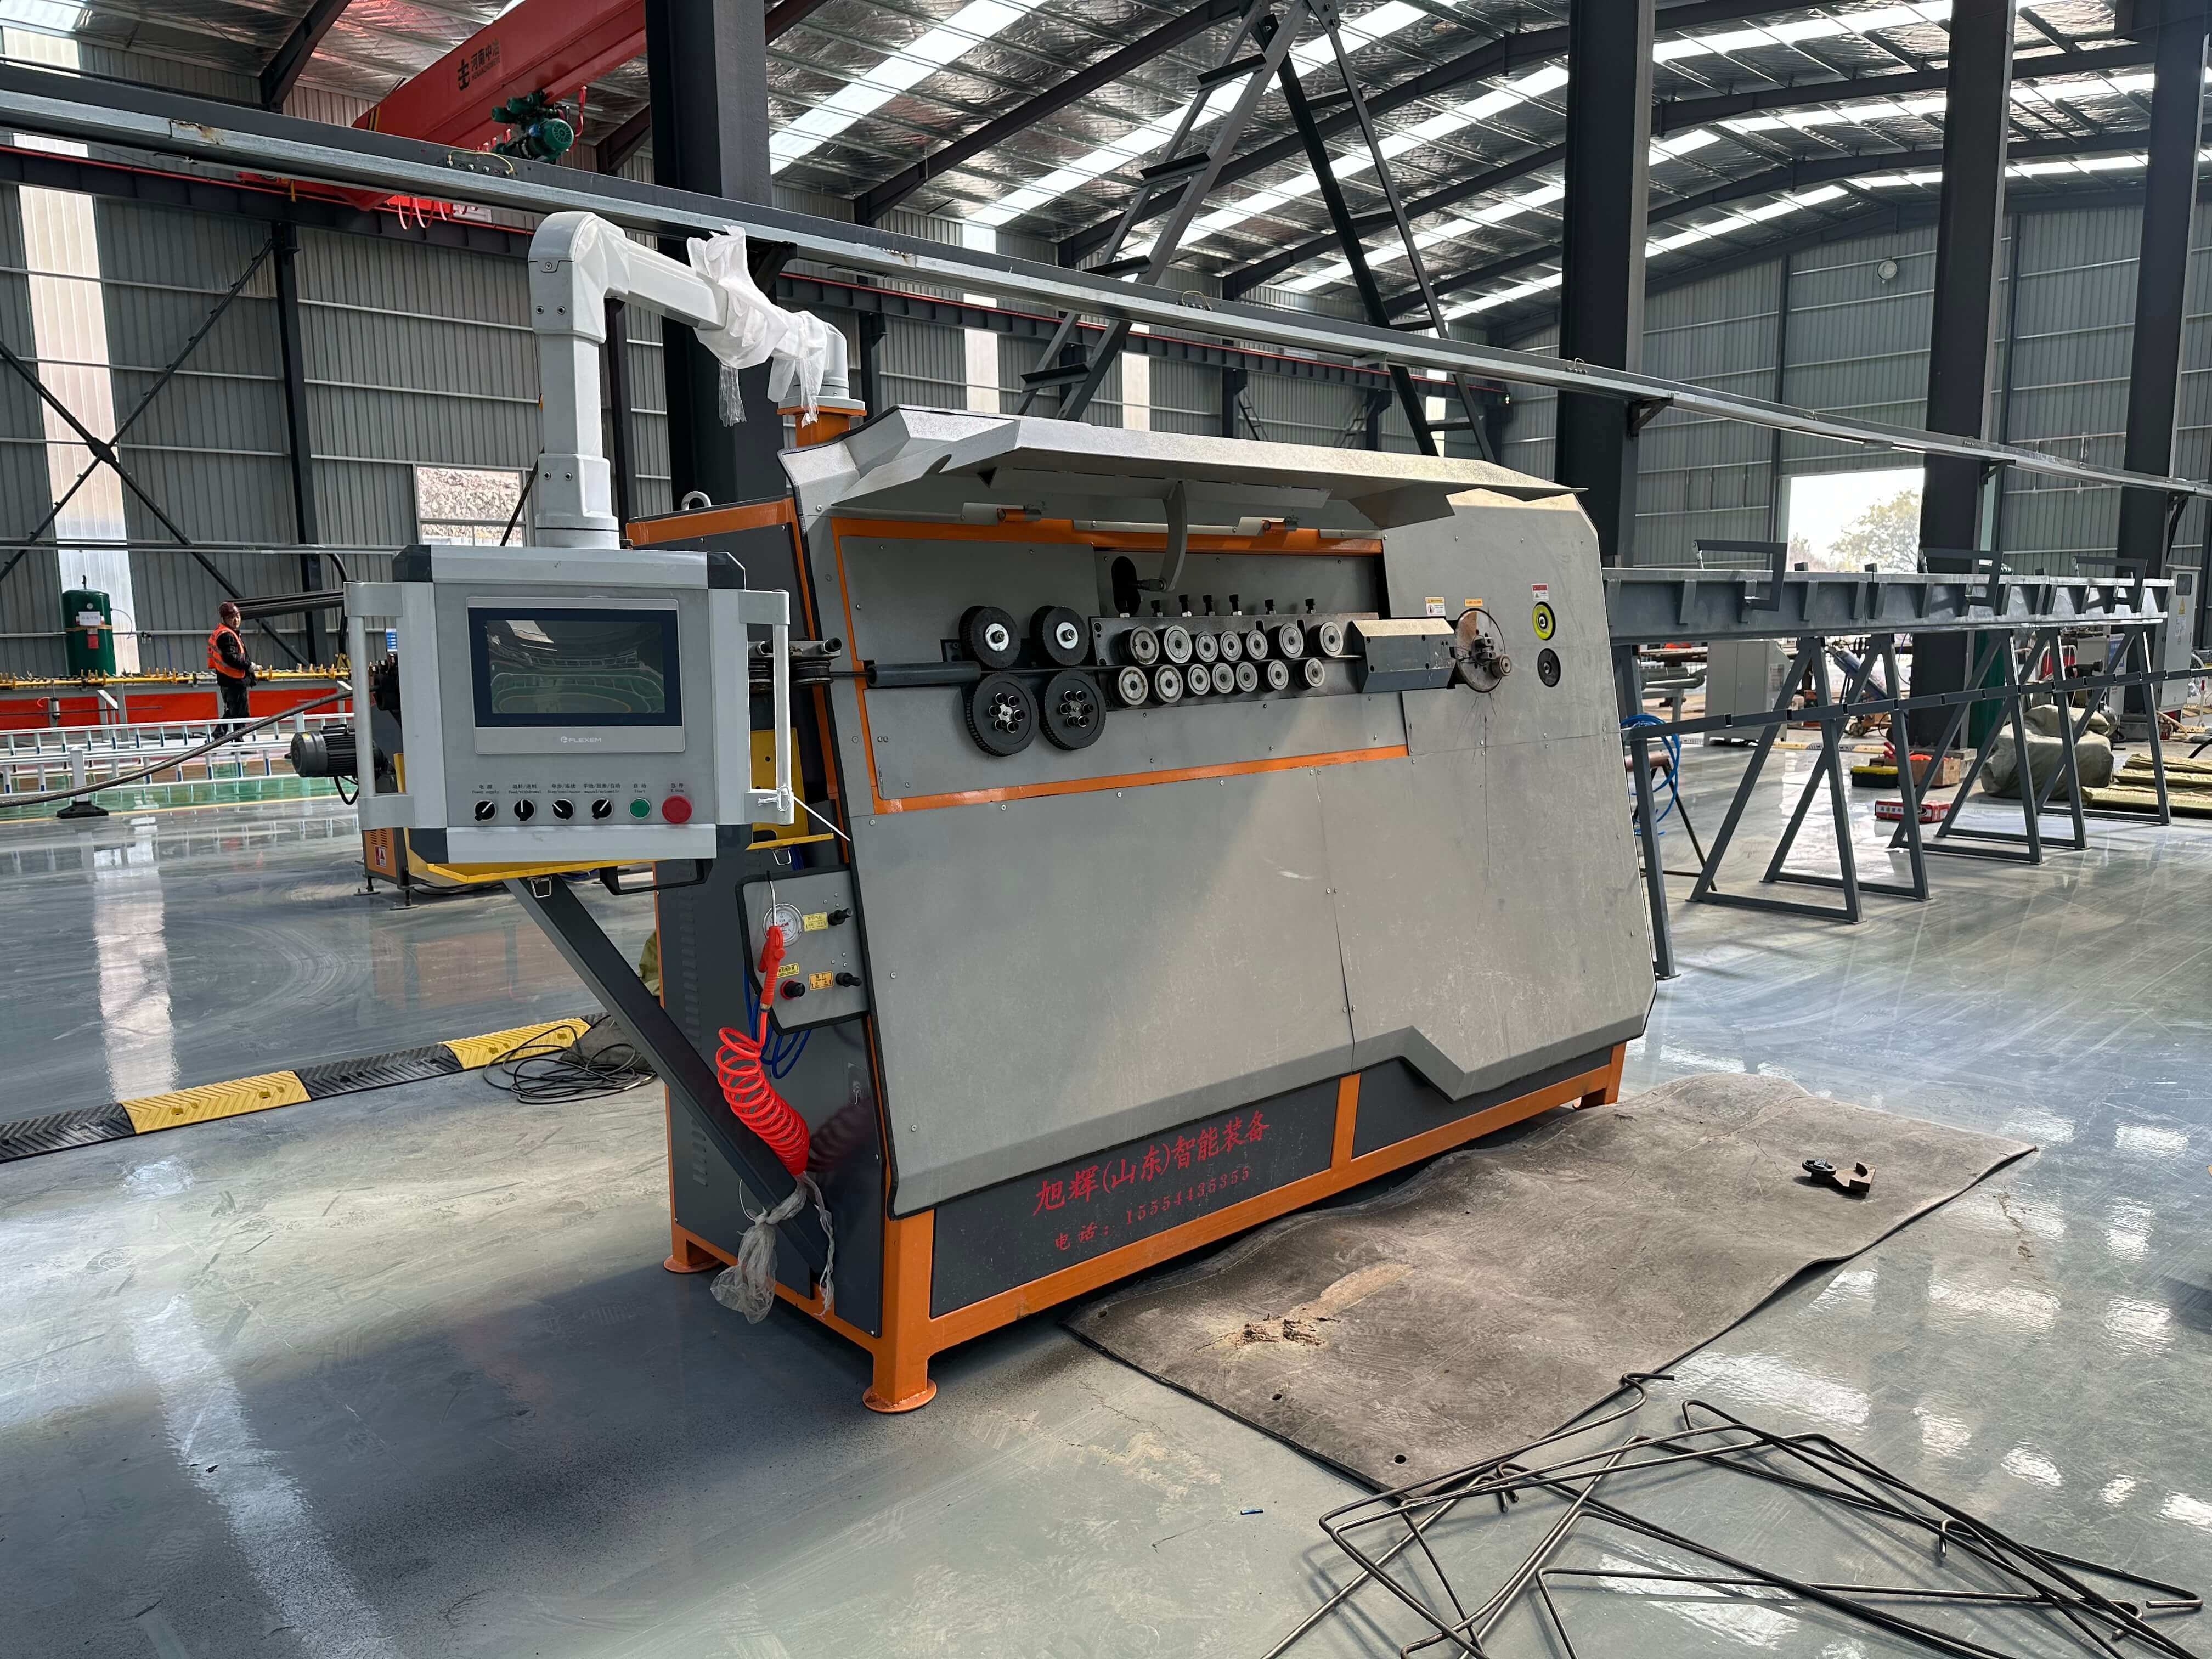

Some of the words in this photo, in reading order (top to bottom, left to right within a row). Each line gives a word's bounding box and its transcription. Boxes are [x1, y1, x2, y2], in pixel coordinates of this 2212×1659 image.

[1032, 1110, 1271, 1216] 旭辉(山东)智能装备
